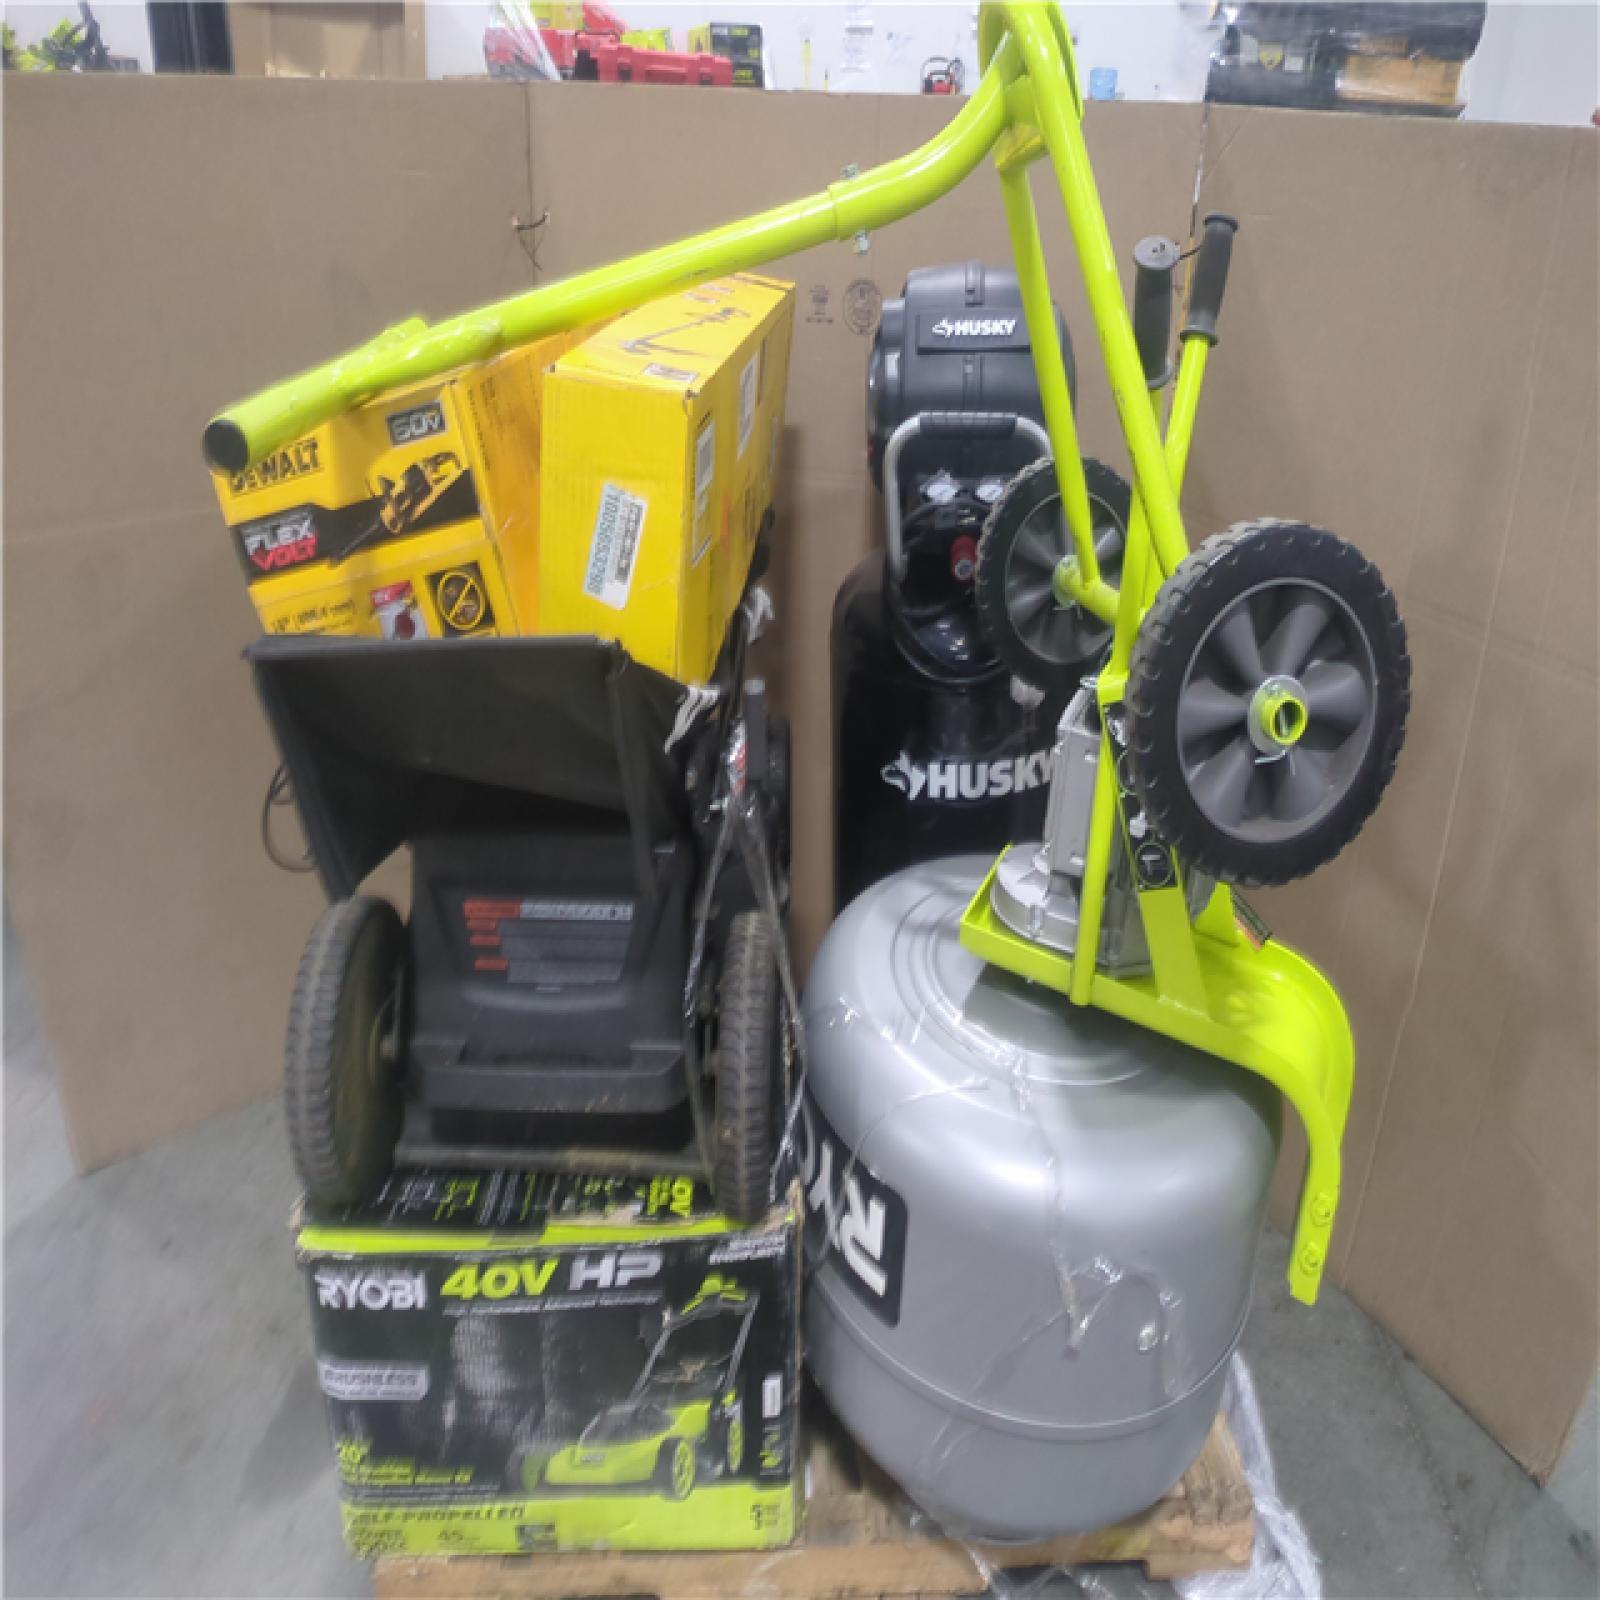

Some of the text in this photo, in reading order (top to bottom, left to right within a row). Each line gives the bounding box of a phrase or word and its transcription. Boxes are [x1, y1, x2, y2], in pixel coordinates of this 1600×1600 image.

[954, 319, 1016, 336] HUSKY
[314, 1267, 426, 1311] RYOBI
[440, 1257, 561, 1301] 40V
[567, 1252, 664, 1291] HP
